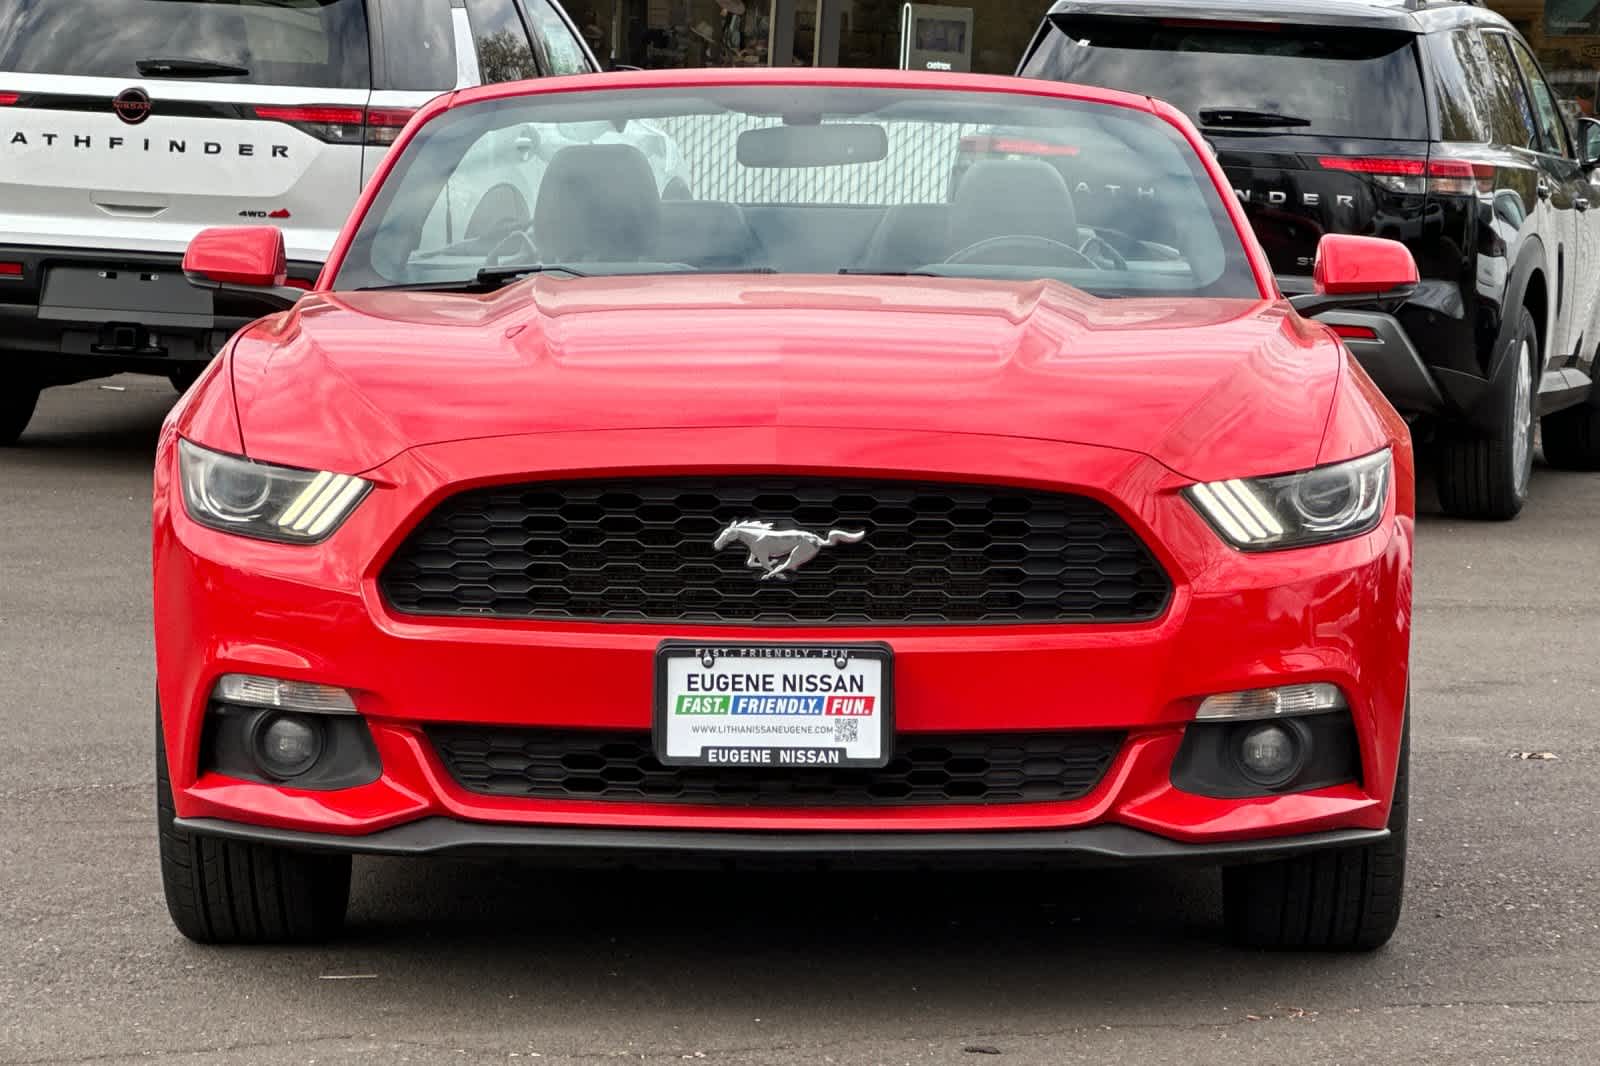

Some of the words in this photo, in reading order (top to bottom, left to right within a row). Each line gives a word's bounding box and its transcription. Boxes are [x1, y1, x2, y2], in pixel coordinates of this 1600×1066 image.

[112, 101, 151, 110] NISSAN
[238, 210, 267, 218] 4WD
[687, 673, 775, 692] EUGENE
[782, 674, 864, 693] NISSAN
[681, 697, 725, 713] FAST.
[737, 698, 820, 713] FRIENDLY.
[831, 698, 870, 714] FUN.
[691, 725, 833, 735] WWW.LITHIANISSANEUGENE.COM
[708, 750, 771, 763] EUGENE
[779, 750, 839, 764] NISSAN
